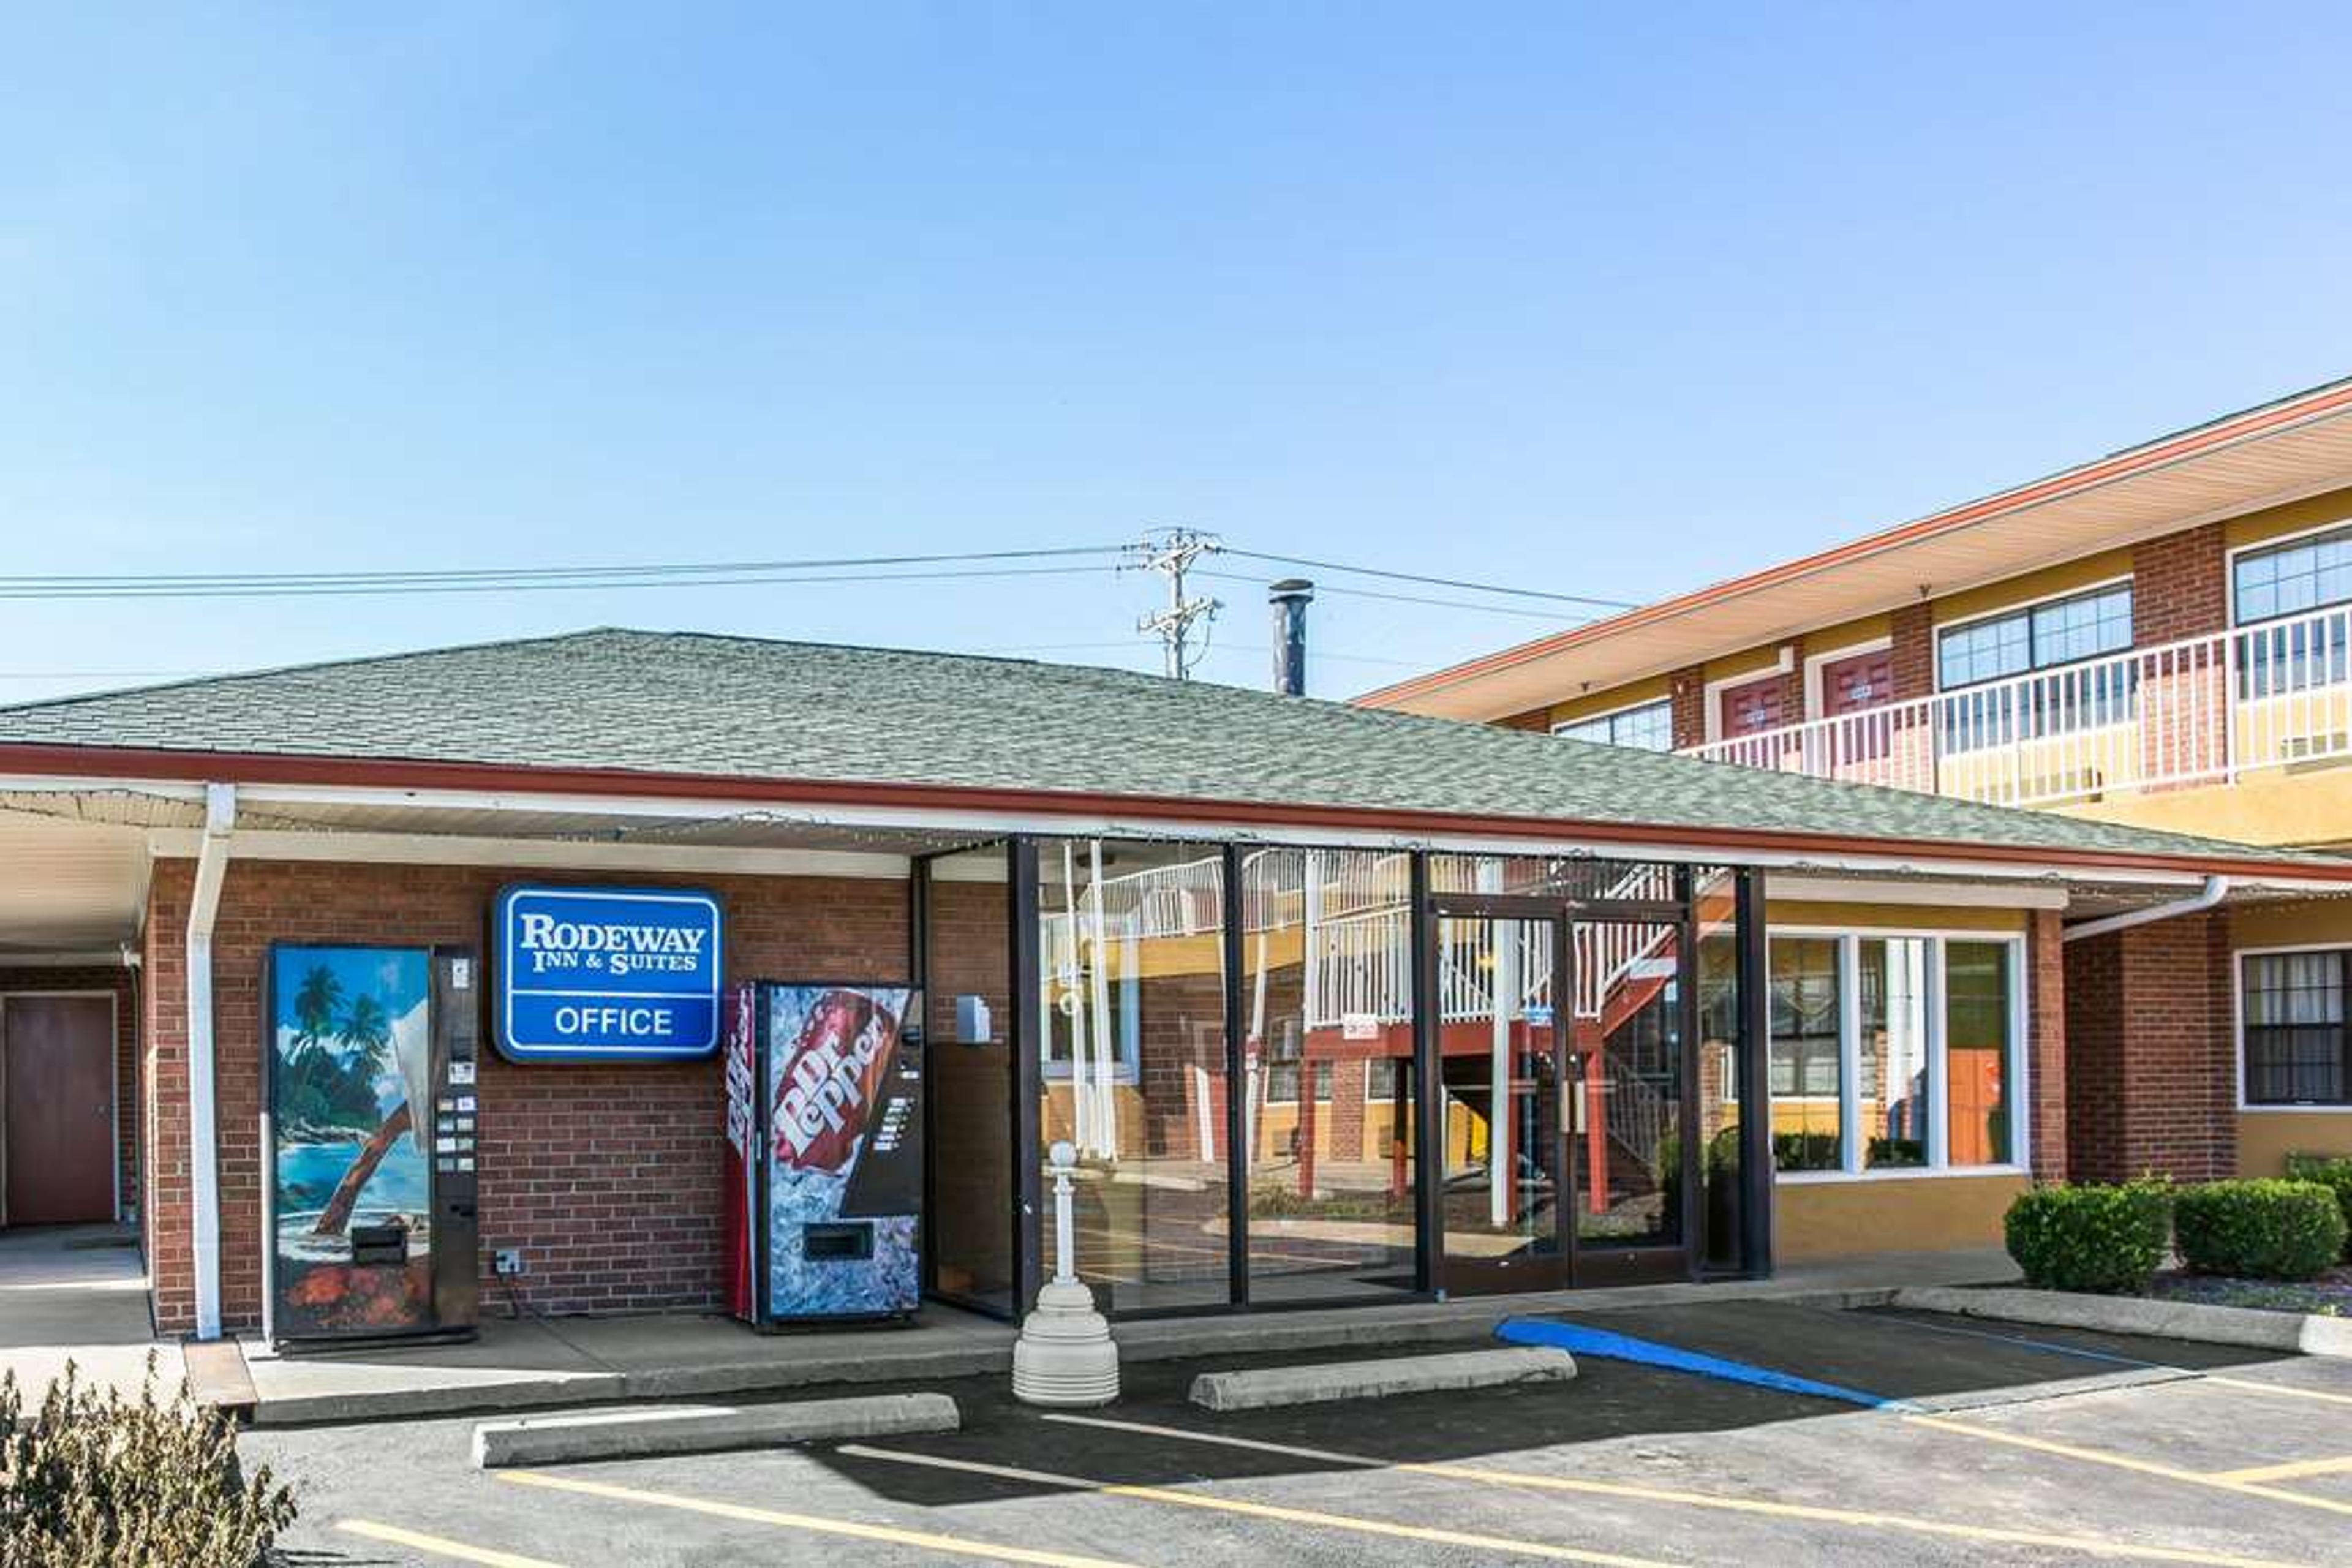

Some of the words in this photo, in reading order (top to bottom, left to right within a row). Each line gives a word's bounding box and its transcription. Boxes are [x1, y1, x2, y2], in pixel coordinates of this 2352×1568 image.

[520, 914, 706, 954] RODEWAY
[532, 952, 578, 973] INN
[586, 956, 603, 969] &
[609, 953, 698, 974] SUITES
[555, 1006, 673, 1034] OFFICE
